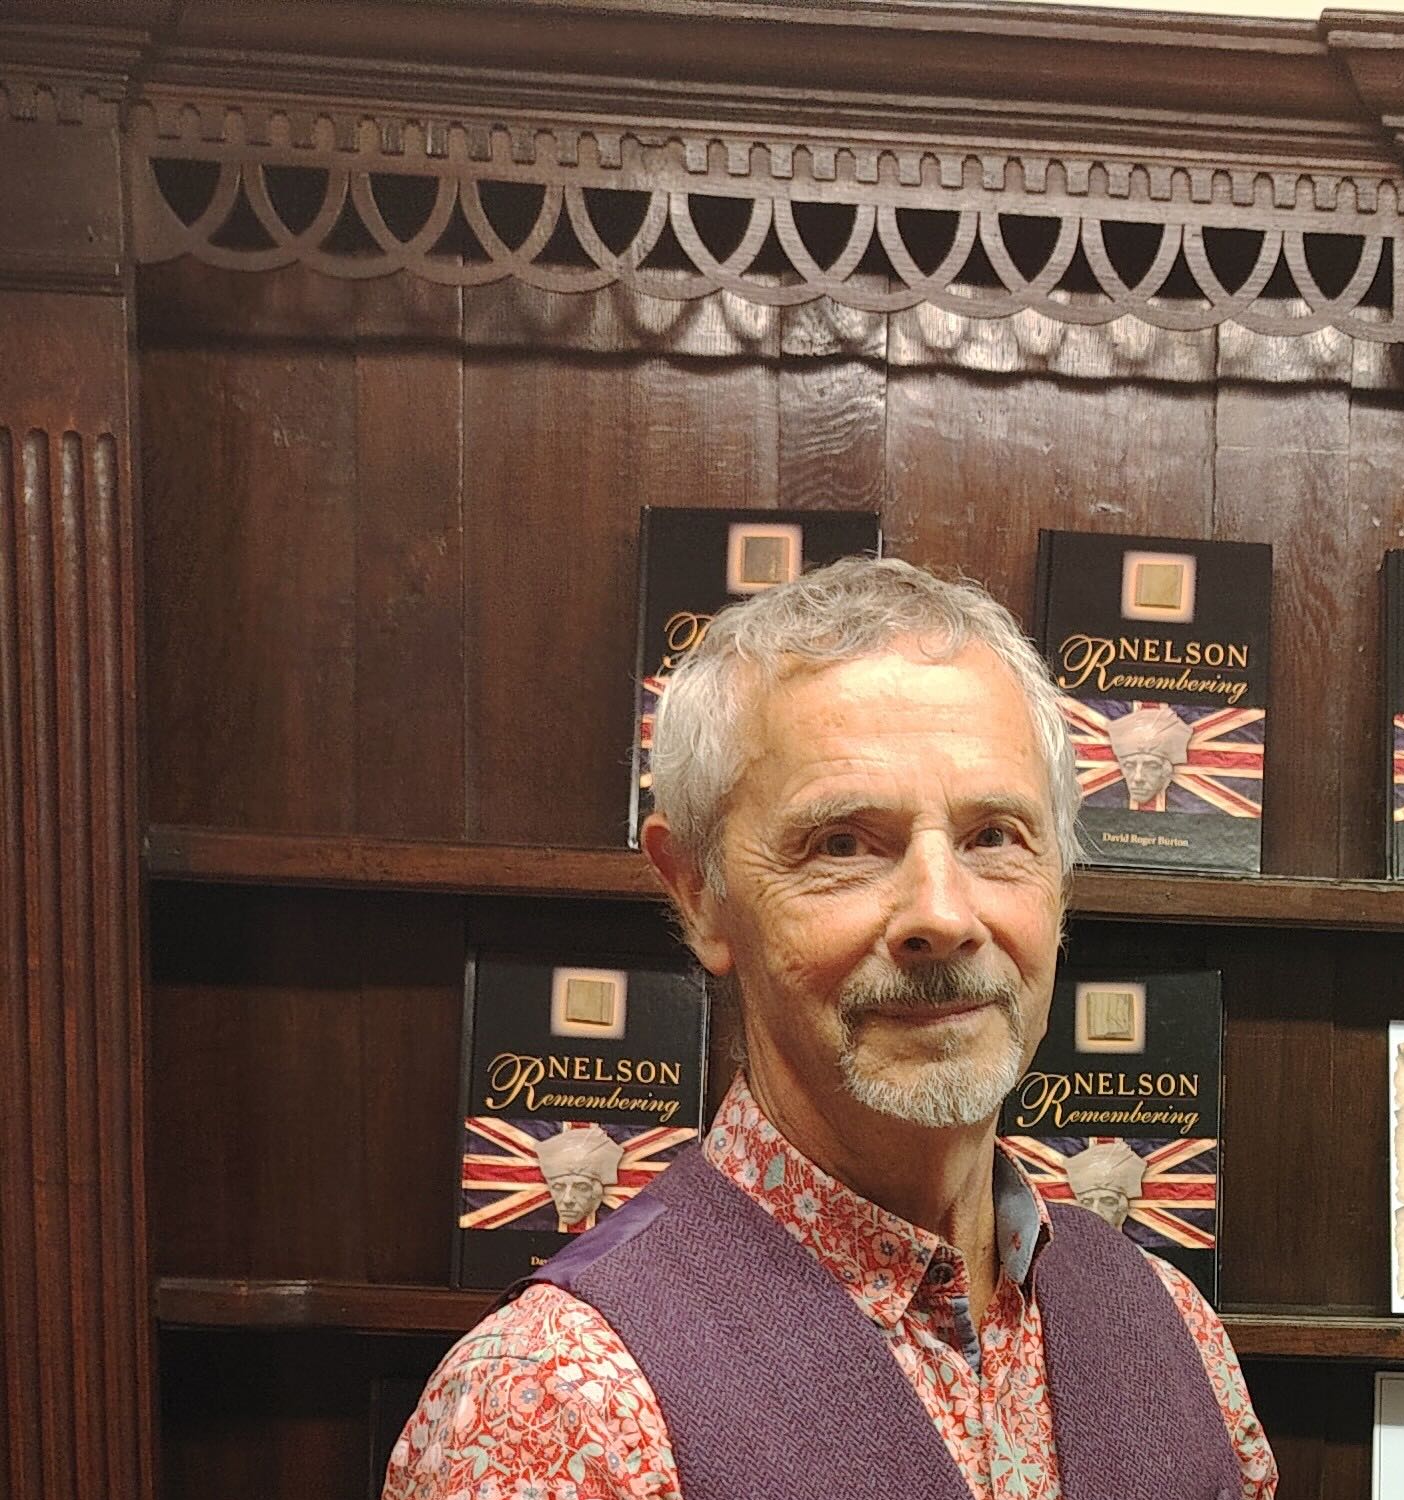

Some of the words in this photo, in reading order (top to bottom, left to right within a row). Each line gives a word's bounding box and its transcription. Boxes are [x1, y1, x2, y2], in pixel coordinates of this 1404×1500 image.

[1119, 637, 1248, 668] NELSON
[1058, 634, 1249, 704] Remembering
[549, 1056, 681, 1085] NELSON
[1074, 1072, 1199, 1097] NELSON
[486, 1053, 681, 1122] Remembering
[1016, 1072, 1199, 1134] Remembering
[531, 1256, 548, 1266] Dav
